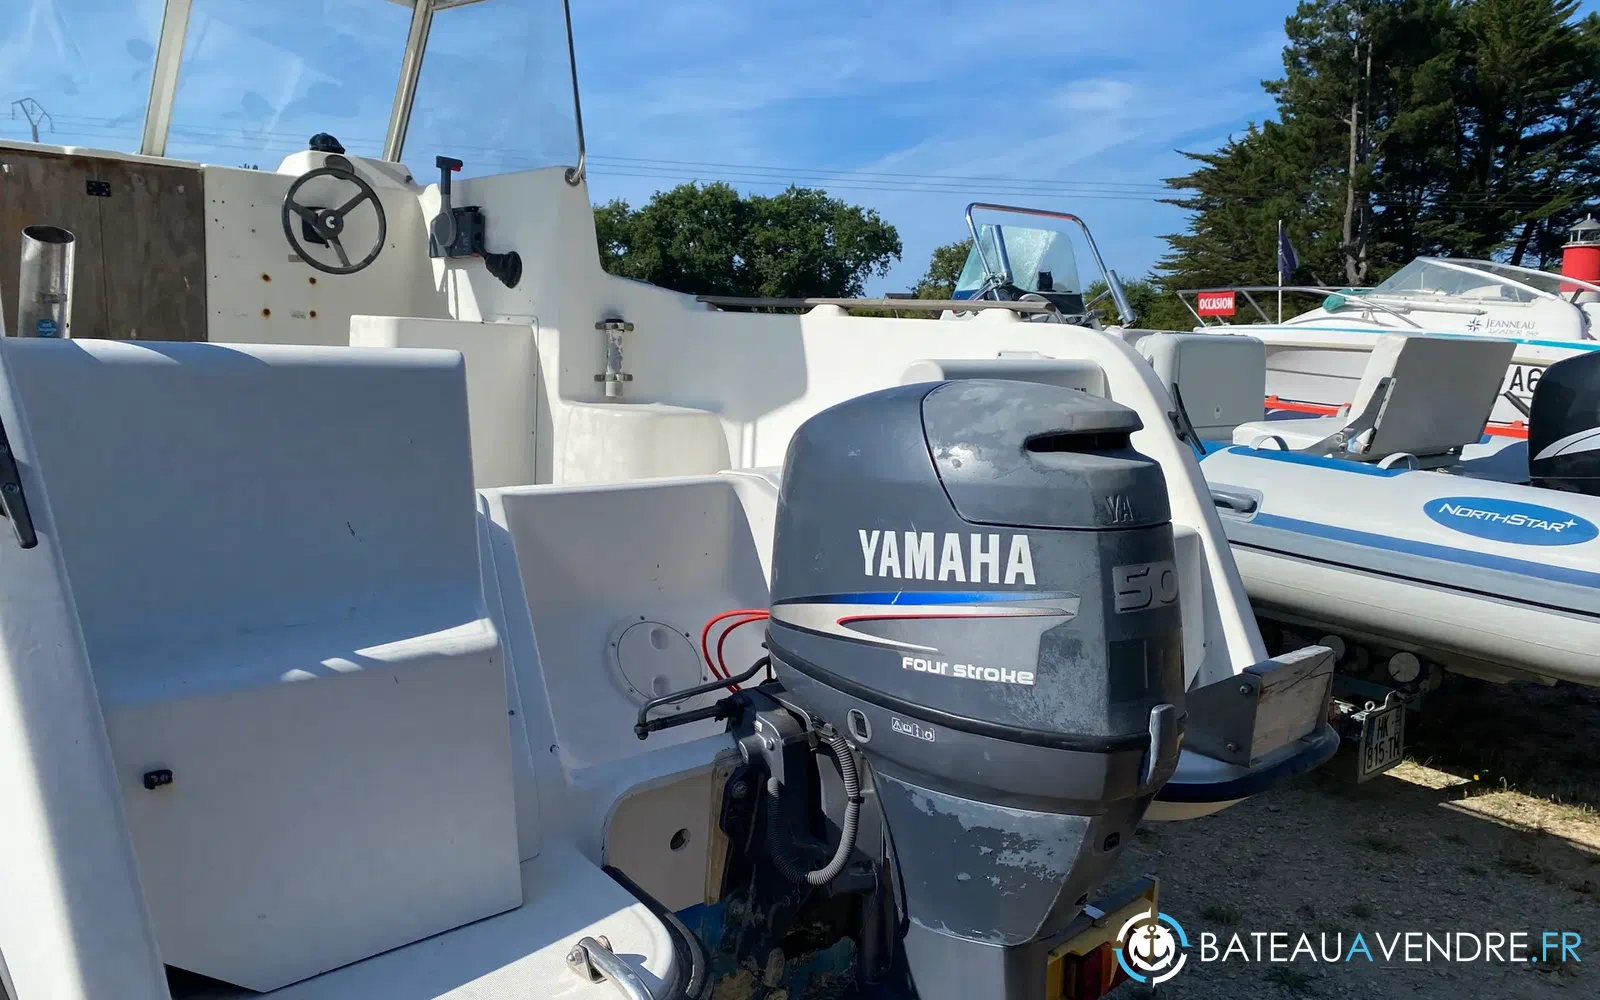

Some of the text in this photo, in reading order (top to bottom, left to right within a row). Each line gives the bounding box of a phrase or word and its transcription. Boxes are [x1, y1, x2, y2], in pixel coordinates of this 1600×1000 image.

[1200, 297, 1233, 310] OCCASION
[1485, 318, 1537, 330] JEANNEAU
[858, 529, 1036, 585] YAMAHA
[1116, 565, 1178, 612] 50
